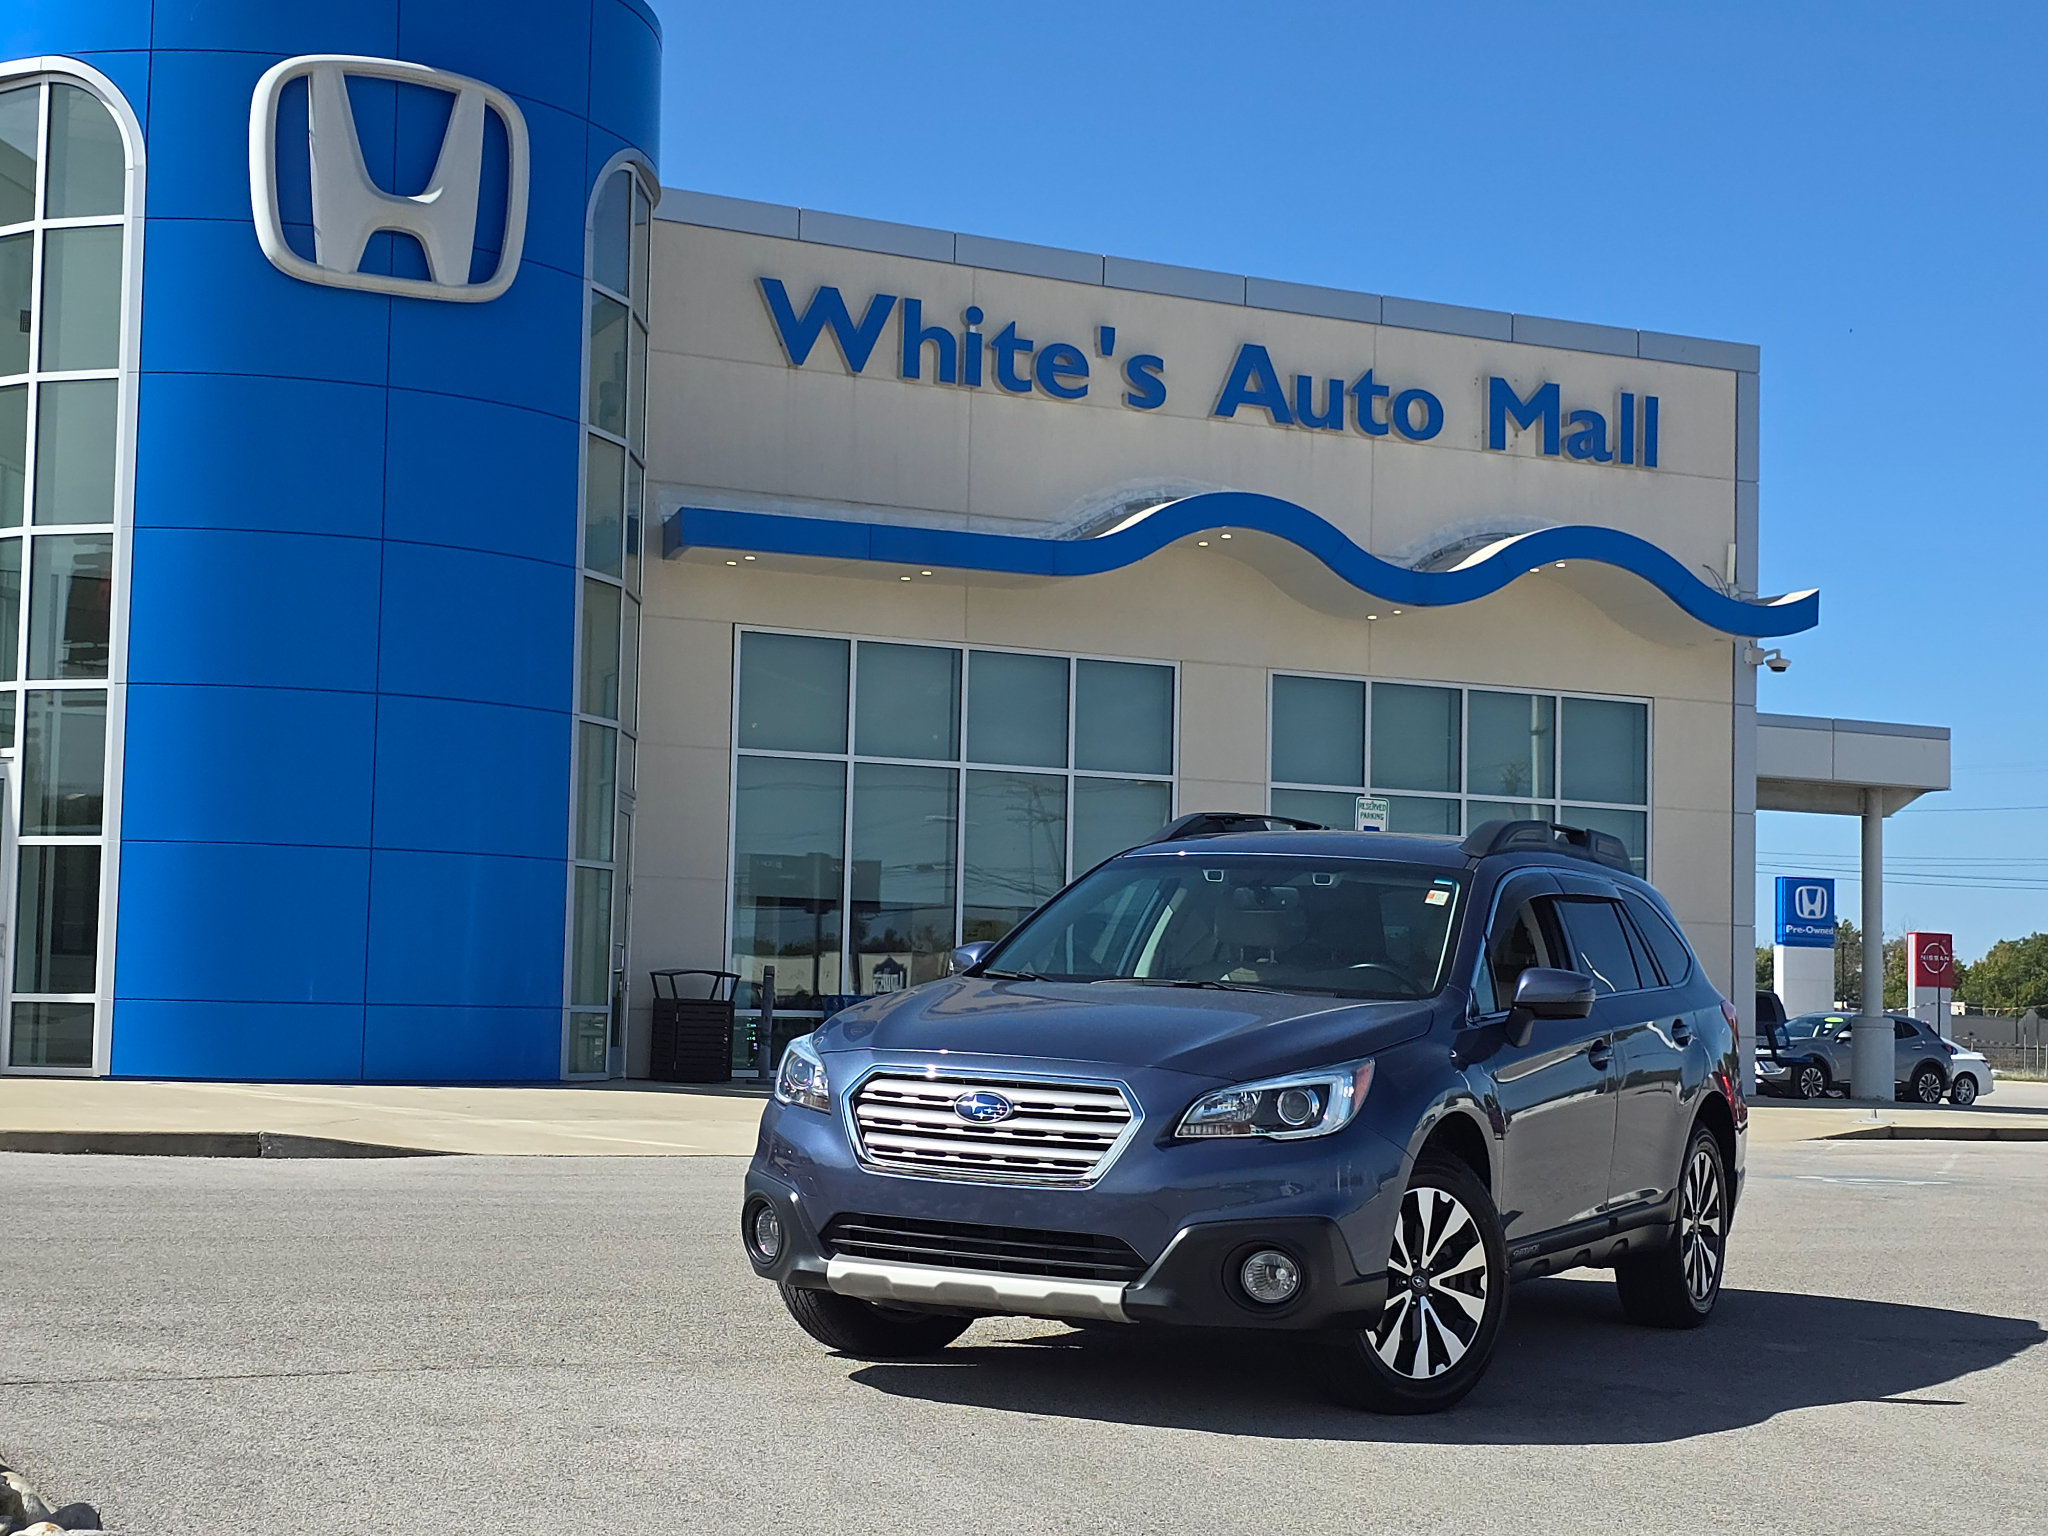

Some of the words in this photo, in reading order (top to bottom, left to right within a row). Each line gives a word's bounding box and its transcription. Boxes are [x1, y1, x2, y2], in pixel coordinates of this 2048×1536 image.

[756, 276, 1167, 411] White's
[1211, 342, 1445, 441] Auto
[1487, 376, 1660, 468] Mall
[1360, 802, 1387, 811] RESERVED
[1360, 811, 1385, 820] PARKING
[1785, 924, 1834, 935] Pre-Owned
